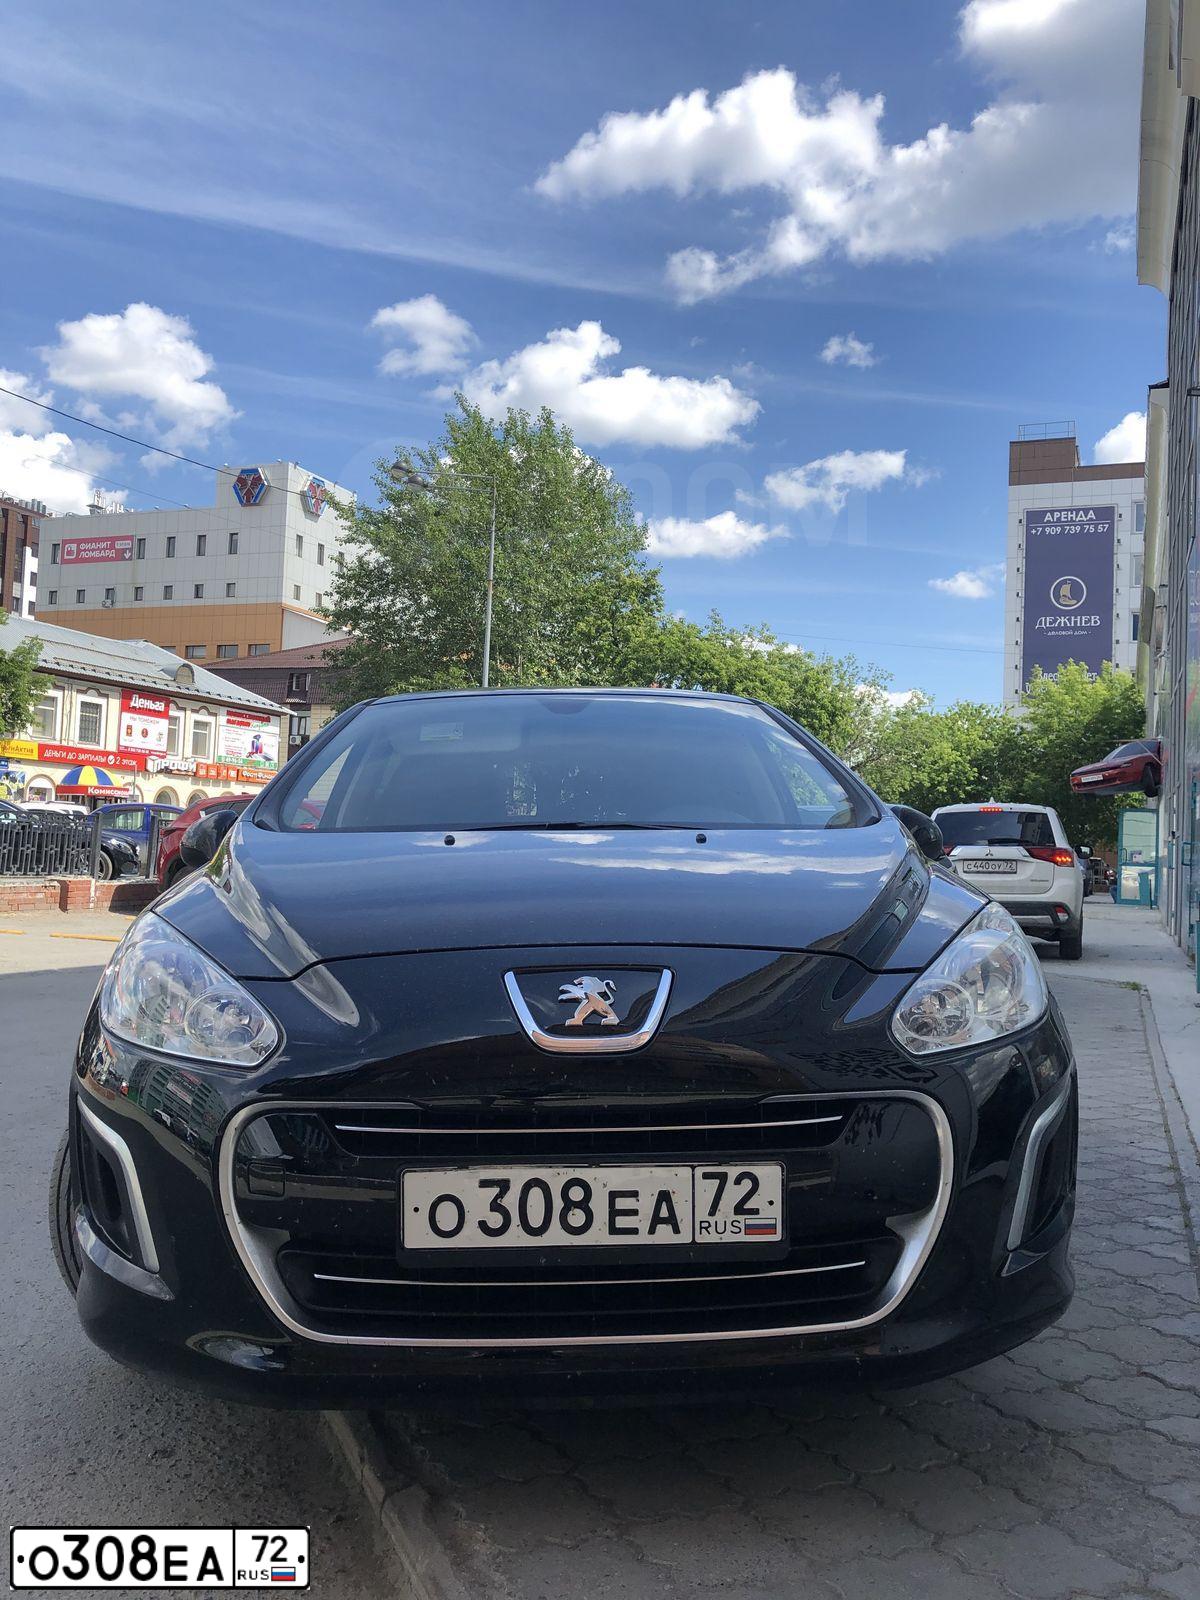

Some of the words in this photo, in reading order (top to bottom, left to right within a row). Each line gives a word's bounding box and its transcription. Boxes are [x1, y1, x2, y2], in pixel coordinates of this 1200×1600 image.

[1044, 510, 1096, 522] АРЕНДА
[1045, 527, 1061, 535] 909
[1064, 526, 1080, 534] 739
[1084, 525, 1094, 533] 75
[1097, 524, 1109, 532] 57
[80, 541, 111, 550] ФИАНИТ
[79, 550, 115, 558] ЛОМБАРД
[1035, 615, 1101, 629] ДЕЖНЕВ
[43, 749, 66, 758] ДЕНЬГИ
[66, 752, 77, 760] ДО
[115, 757, 120, 765] 2
[1004, 861, 1014, 870] 72
[702, 1171, 760, 1217] 72
[699, 1220, 743, 1235] RUS
